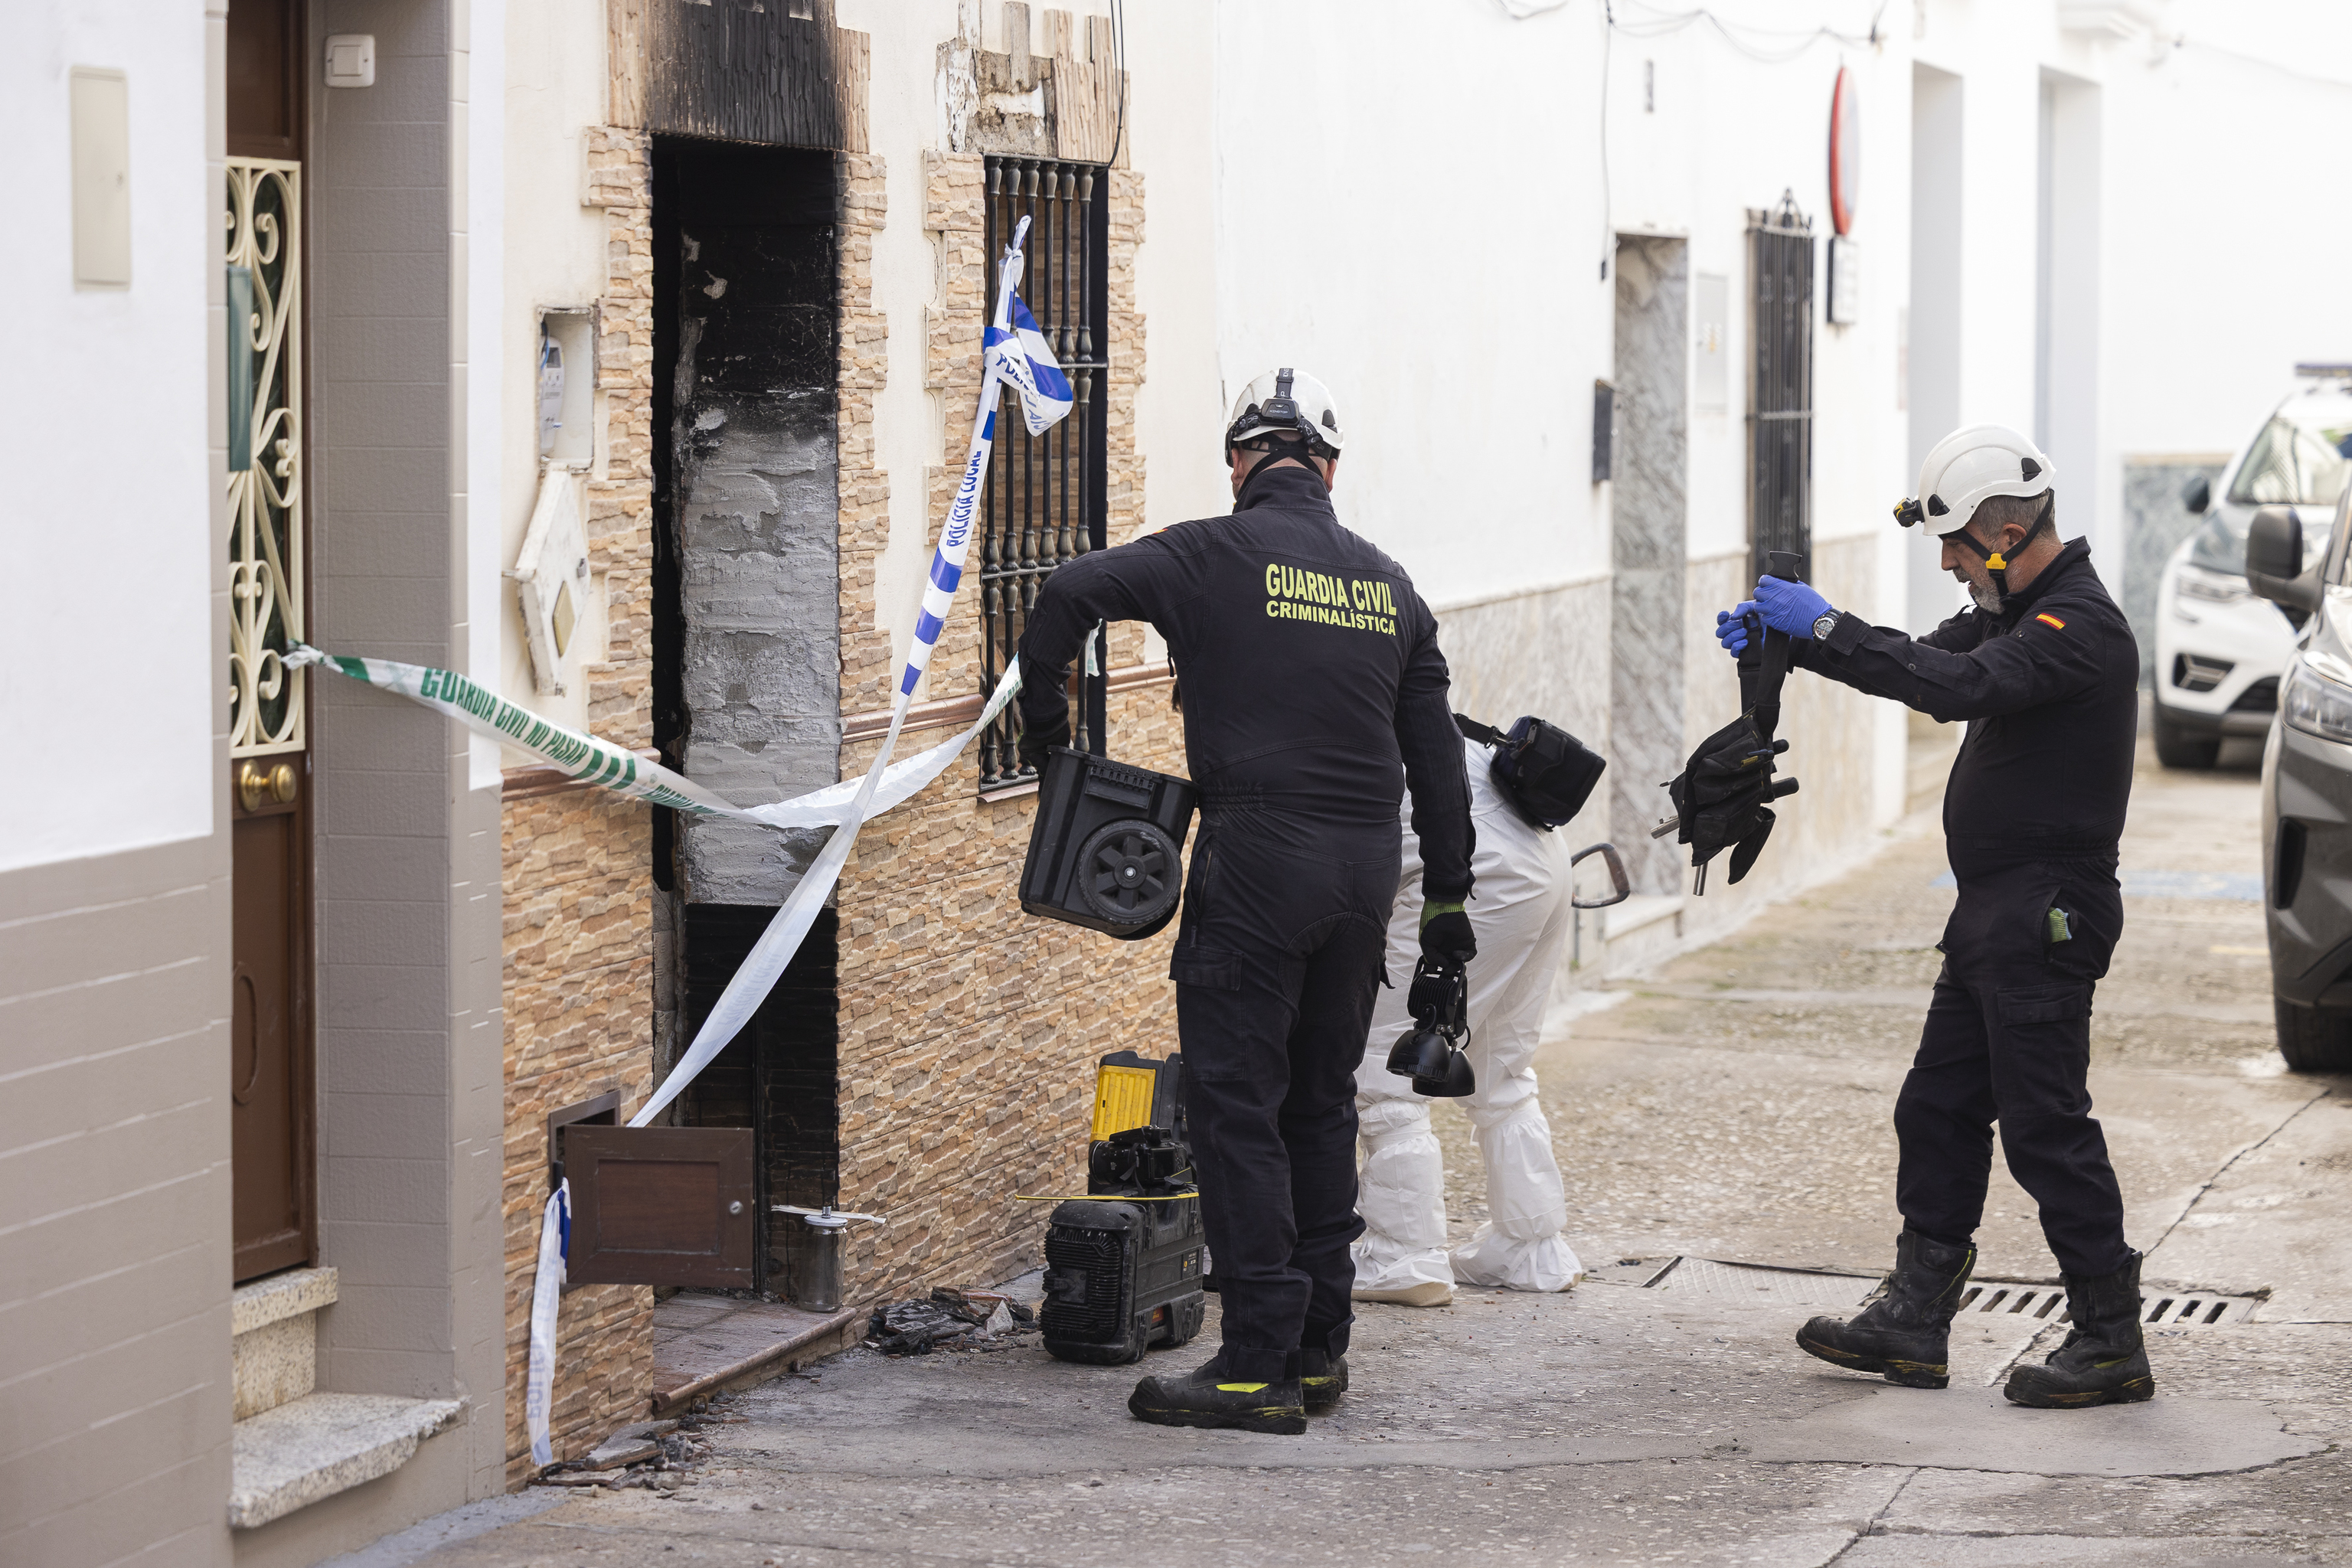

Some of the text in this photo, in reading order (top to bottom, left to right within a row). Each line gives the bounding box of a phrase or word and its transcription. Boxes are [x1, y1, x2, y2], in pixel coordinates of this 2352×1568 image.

[946, 449, 982, 547] POLICIA LOCAL
[1266, 564, 1396, 616] GUARDIA CIVIL
[1266, 600, 1396, 635] CRIMINALÍSTICA
[420, 668, 589, 766] GUARDIA CIVIL NO PASAR
